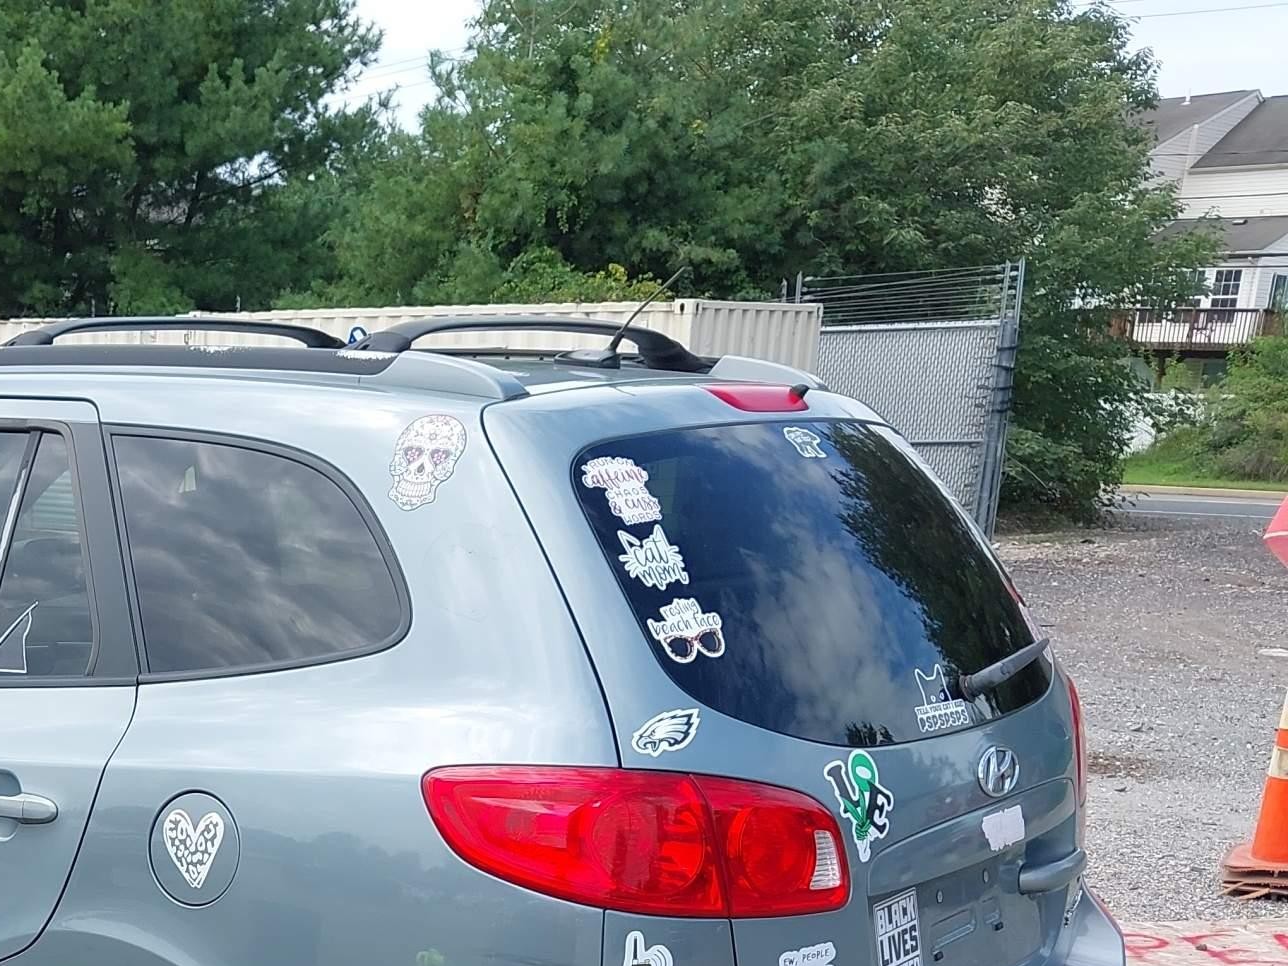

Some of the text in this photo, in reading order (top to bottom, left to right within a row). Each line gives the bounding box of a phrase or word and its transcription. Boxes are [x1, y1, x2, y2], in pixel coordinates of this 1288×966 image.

[589, 459, 613, 469] RUN
[617, 458, 634, 467] ON
[607, 486, 648, 500] CHAOS
[610, 497, 660, 514] & cuss
[623, 511, 662, 523] WORDS
[633, 538, 669, 567] cat
[637, 563, 688, 588] mom
[662, 600, 700, 618] resting
[650, 611, 721, 636] beach face
[876, 895, 916, 935] BLACK
[783, 948, 830, 966] EW, PEOPLE
